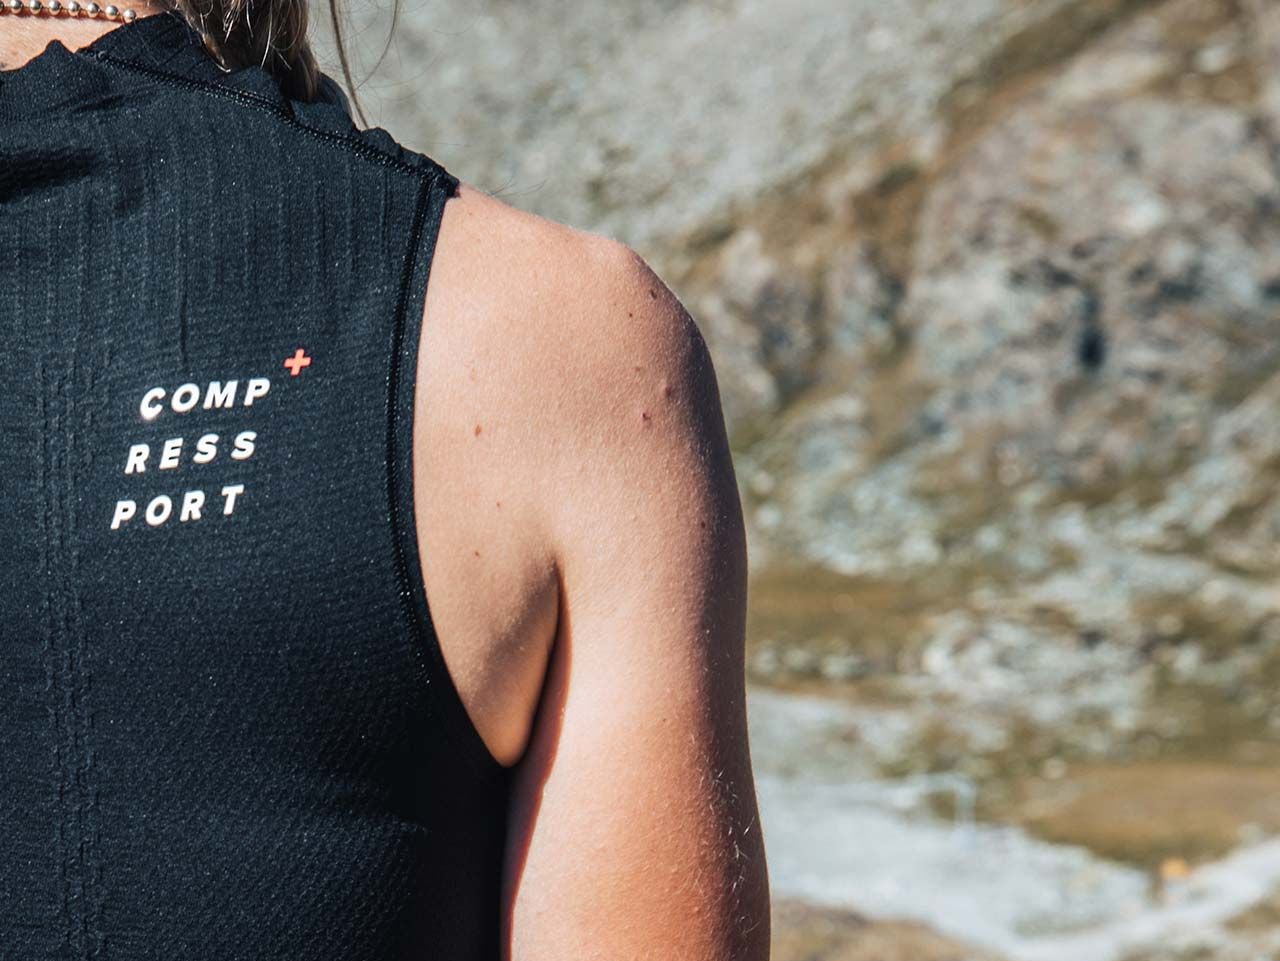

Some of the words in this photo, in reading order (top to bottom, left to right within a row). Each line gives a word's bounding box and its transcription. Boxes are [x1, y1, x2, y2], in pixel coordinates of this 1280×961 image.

[139, 377, 271, 421] COMP
[124, 431, 257, 474] RESS
[110, 484, 245, 530] PORT
